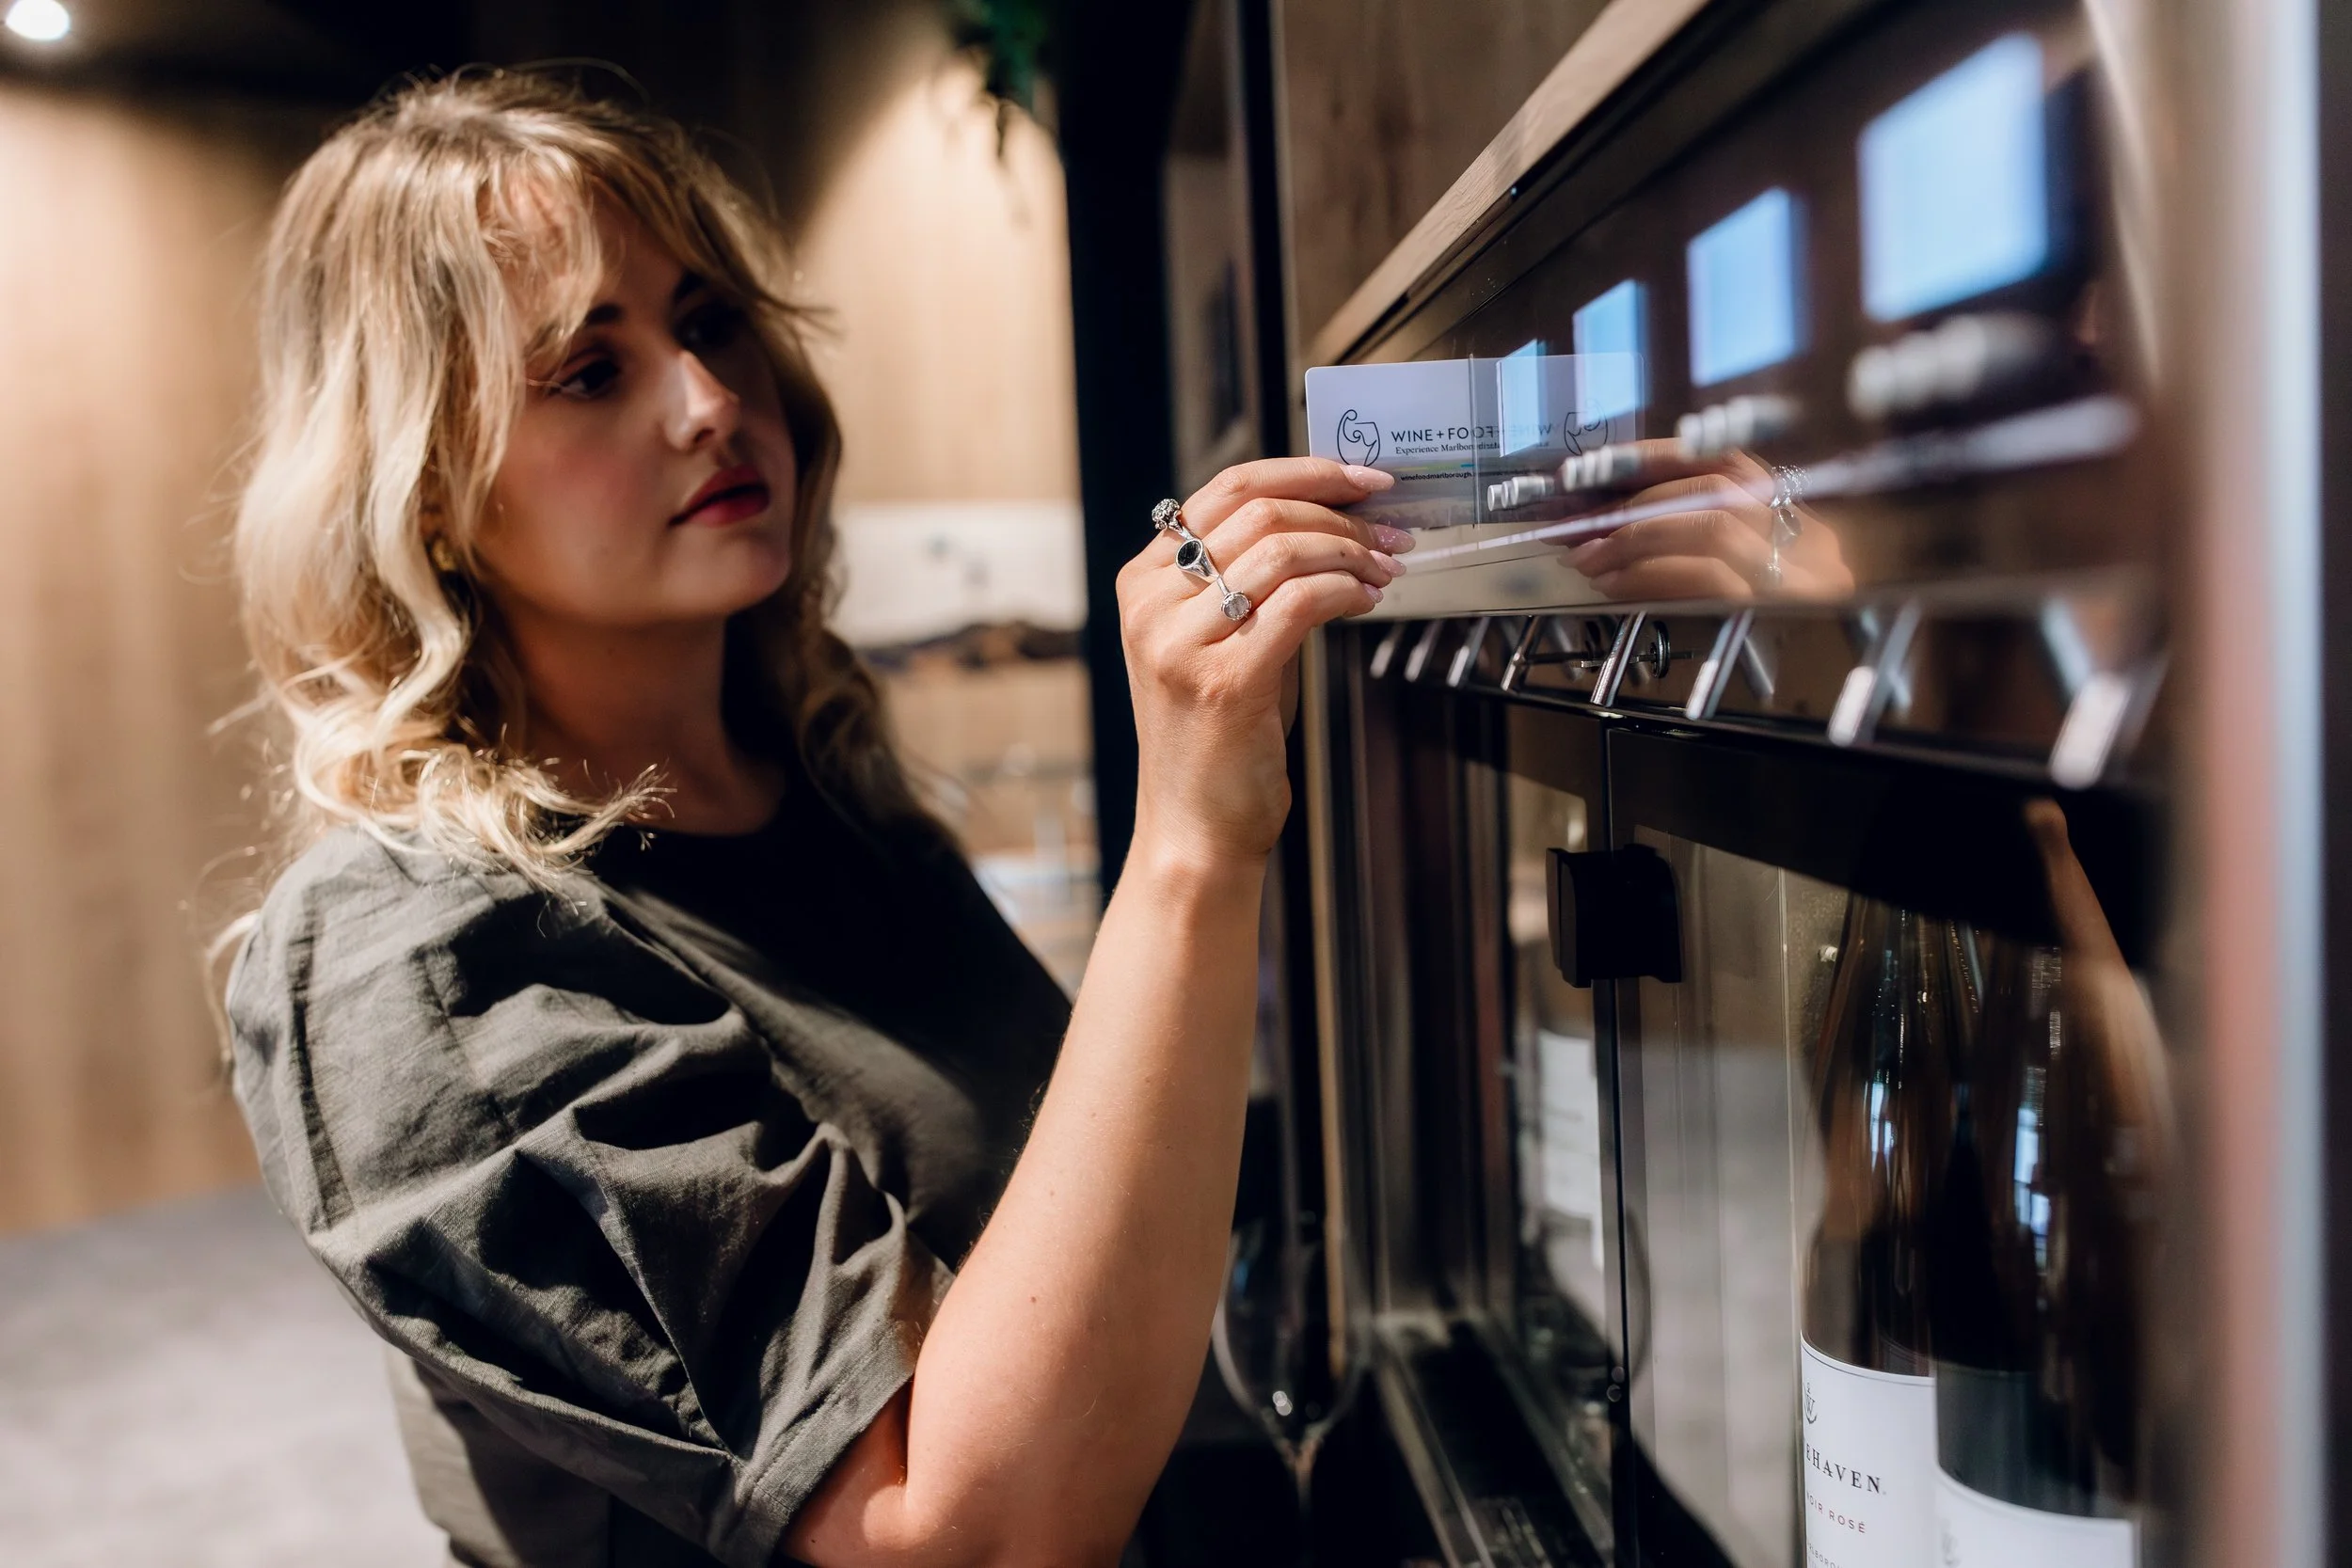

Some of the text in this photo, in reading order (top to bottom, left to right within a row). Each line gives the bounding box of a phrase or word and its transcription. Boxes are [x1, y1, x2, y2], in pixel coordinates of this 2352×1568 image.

[1395, 445, 1439, 456] Experience
[1805, 1442, 1882, 1494] EHAVEN
[1829, 1511, 1866, 1534] ROSÉ
